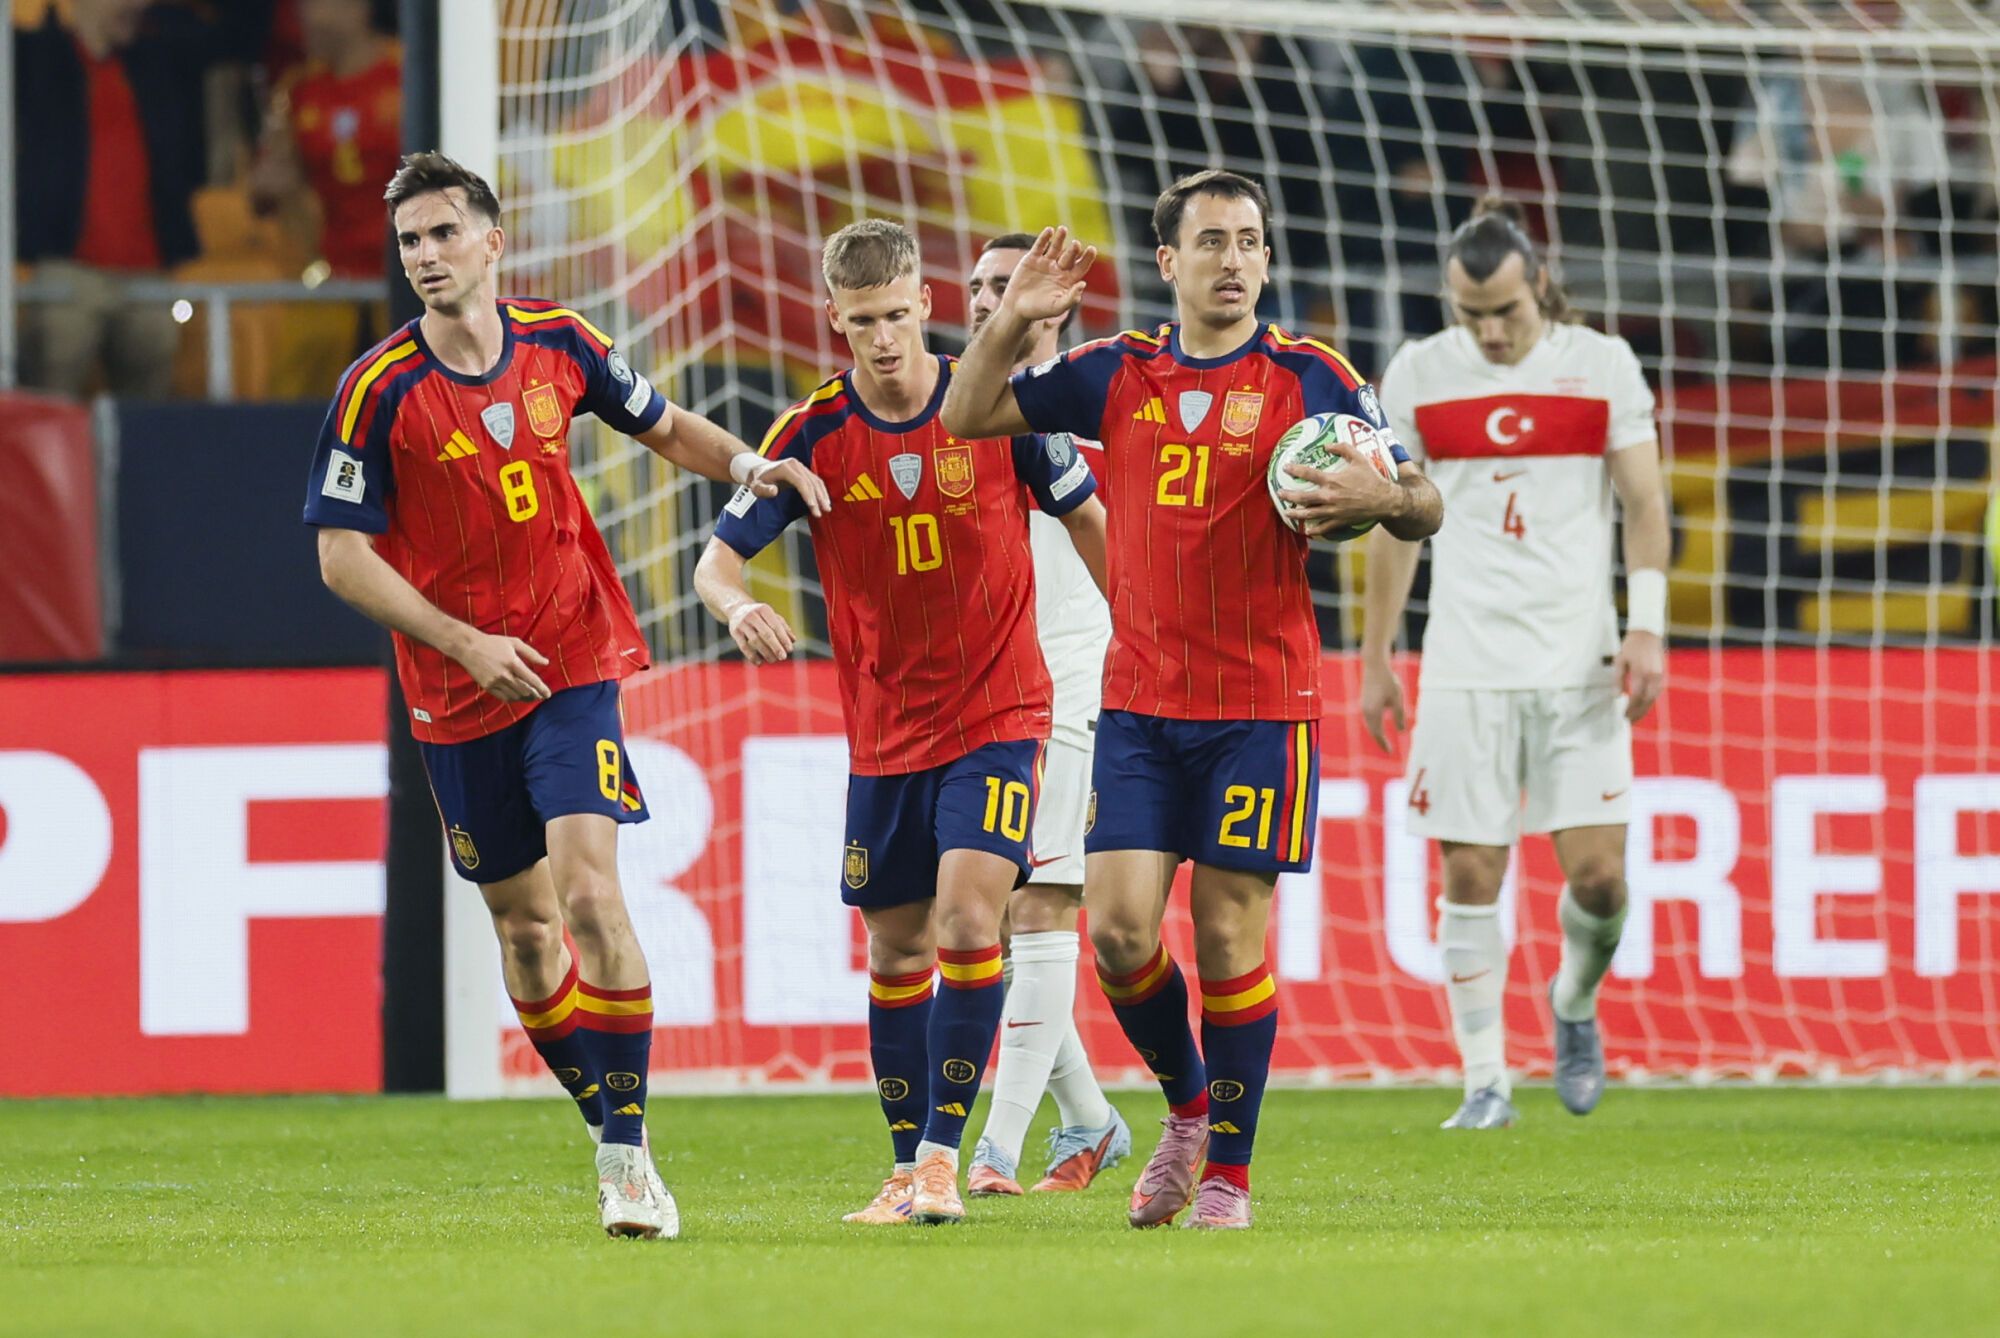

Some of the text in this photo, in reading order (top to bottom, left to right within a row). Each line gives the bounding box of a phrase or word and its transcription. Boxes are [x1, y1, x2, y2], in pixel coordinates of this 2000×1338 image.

[500, 460, 539, 523] 8
[1157, 444, 1210, 507] 21
[889, 513, 943, 575] 10
[1503, 492, 1526, 541] 4
[596, 739, 622, 802] 8
[1409, 767, 1432, 816] 4
[983, 777, 1030, 843] 10
[1219, 785, 1275, 850] 21
